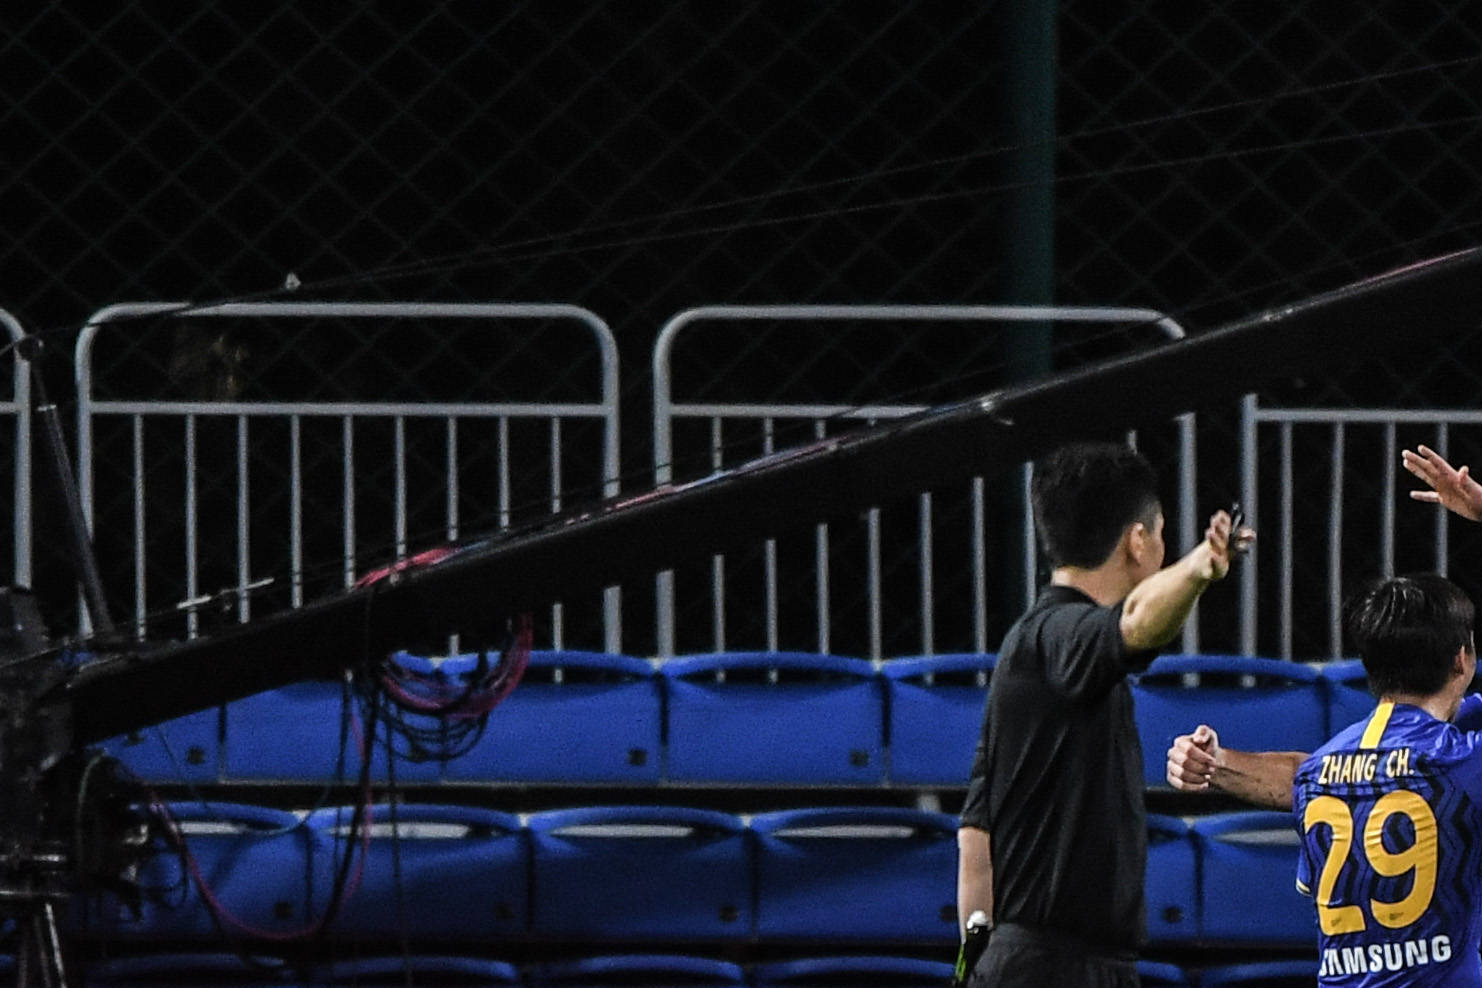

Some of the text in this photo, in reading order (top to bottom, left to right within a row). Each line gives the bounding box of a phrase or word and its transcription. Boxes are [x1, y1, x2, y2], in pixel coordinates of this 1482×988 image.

[1318, 748, 1415, 784] ZHANG CH.
[1304, 789, 1438, 936] 29
